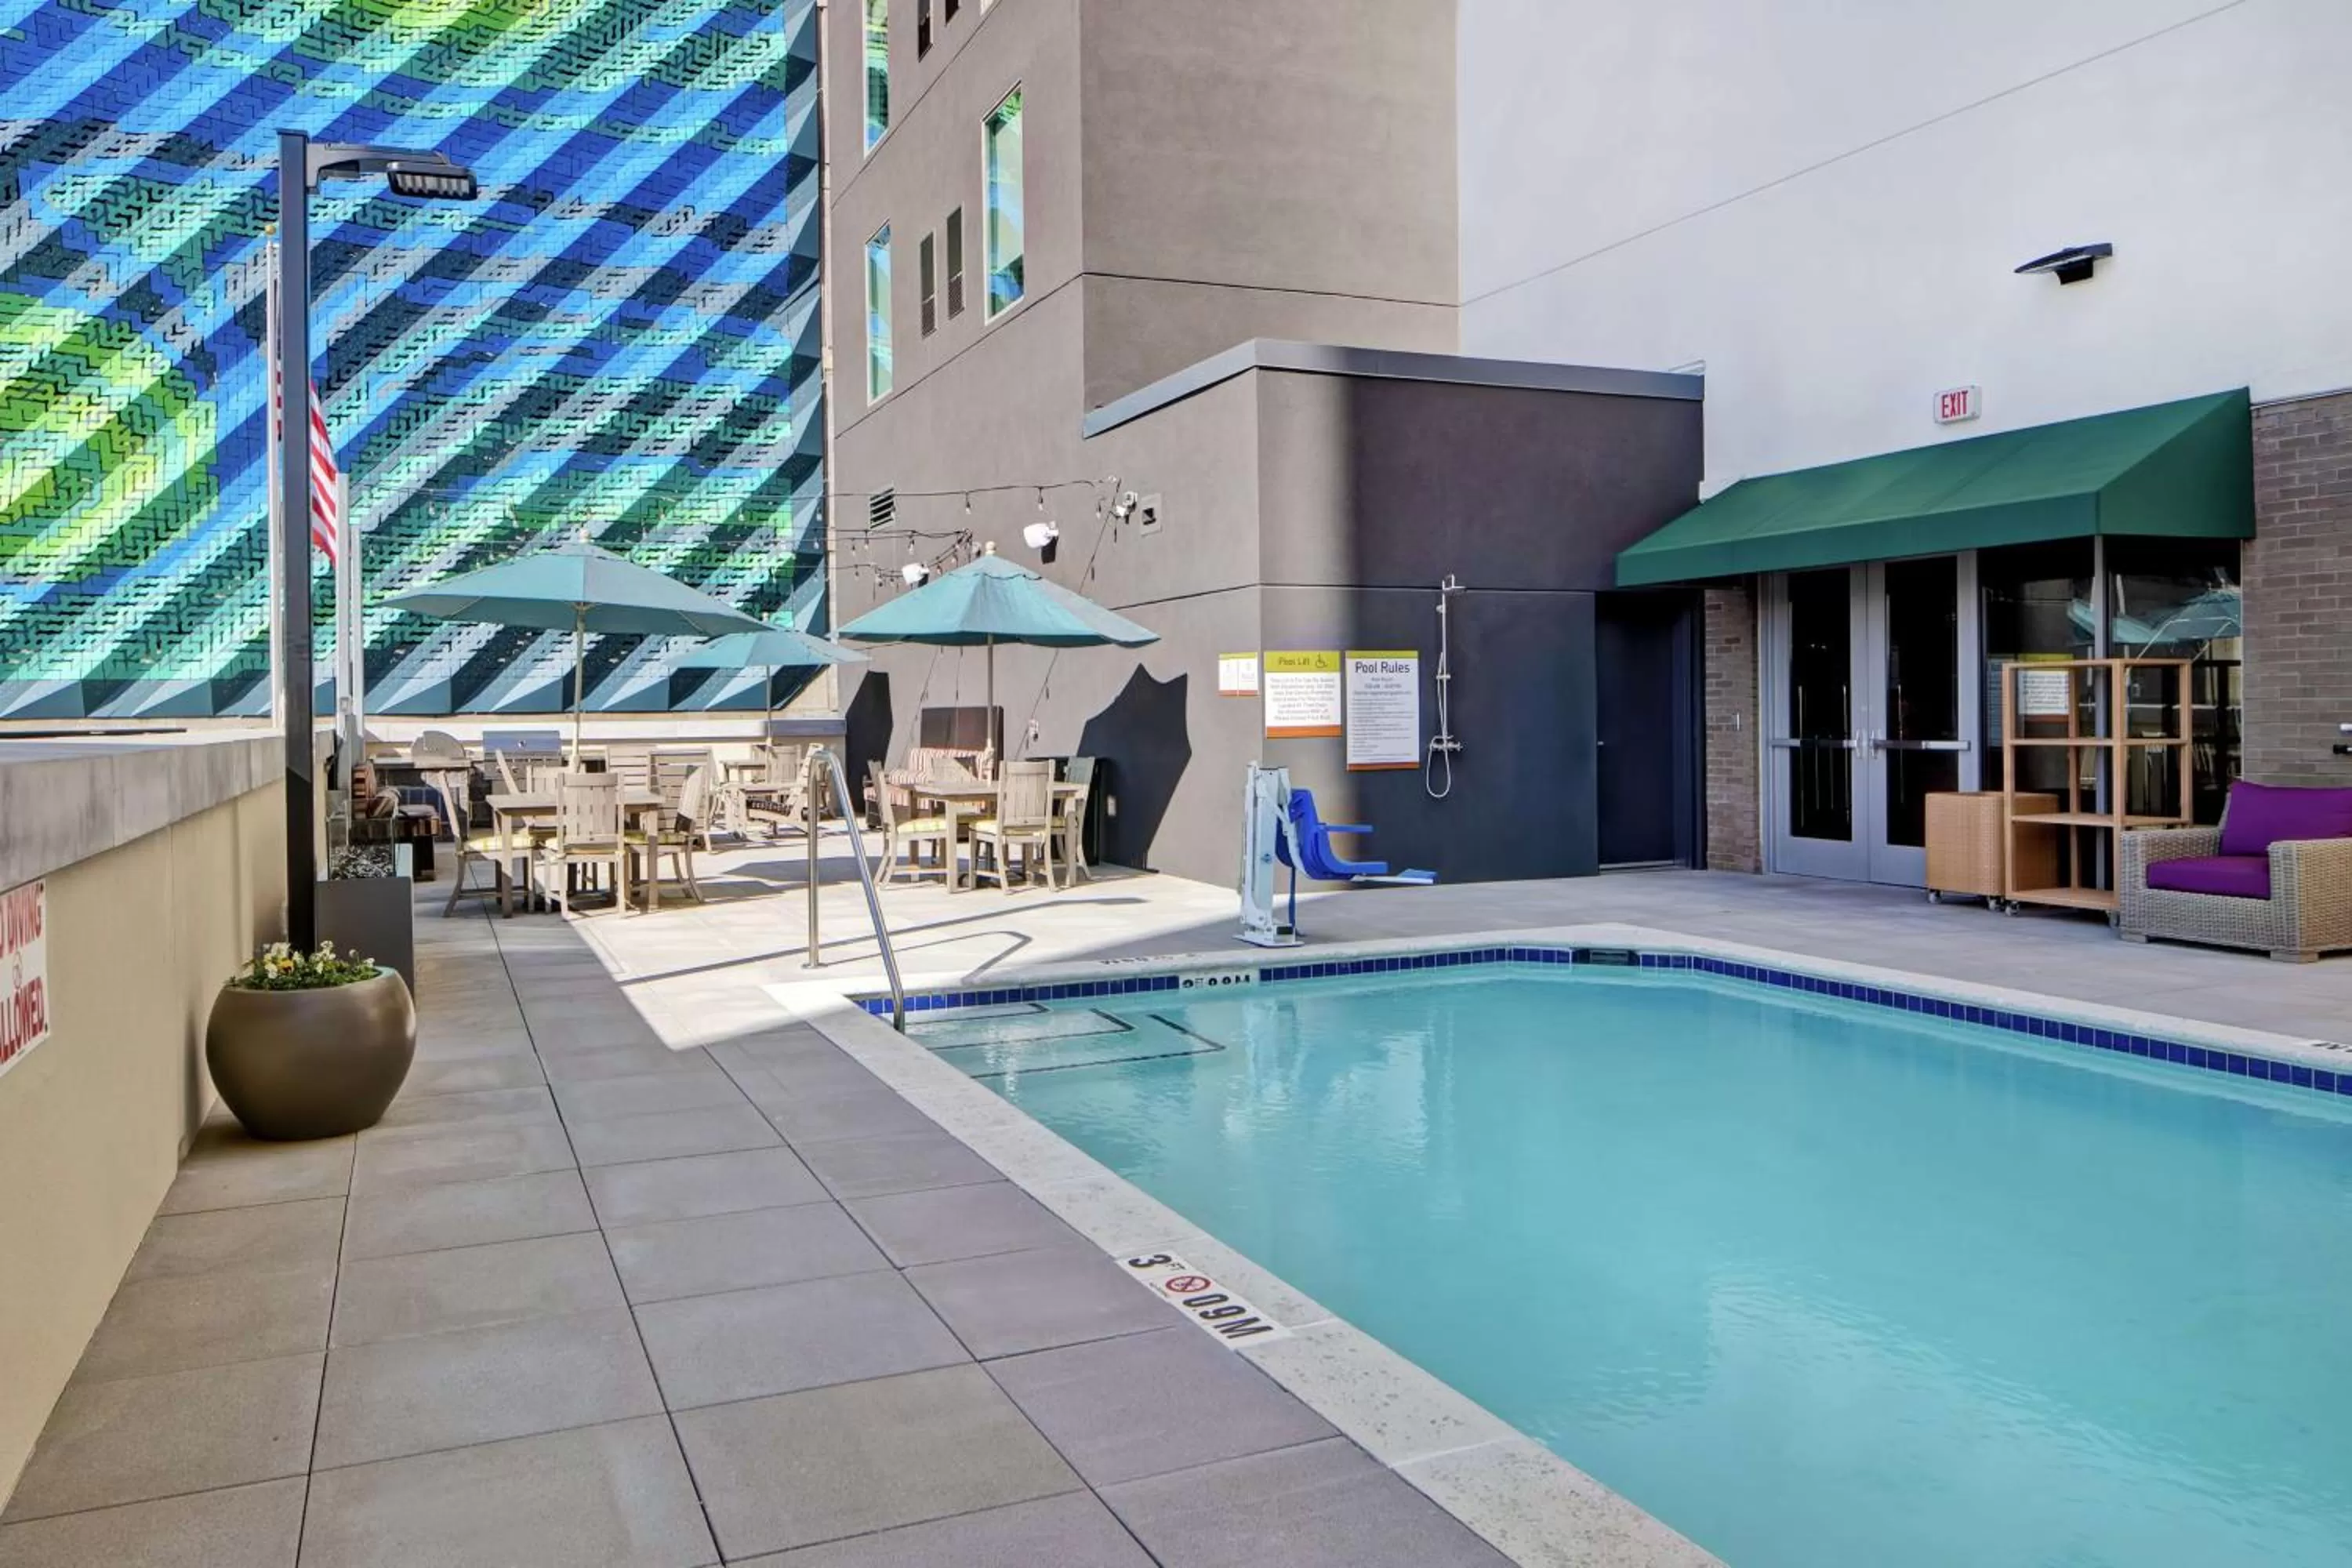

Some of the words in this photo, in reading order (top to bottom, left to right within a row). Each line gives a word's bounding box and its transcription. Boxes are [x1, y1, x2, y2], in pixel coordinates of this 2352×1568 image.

[1942, 390, 1968, 418] EXIT
[1279, 656, 1295, 666] Pool
[1355, 660, 1377, 673] Pool
[1381, 660, 1410, 673] Rules
[8, 883, 42, 954] DIVING
[0, 976, 44, 1064] LLOWED
[1128, 1254, 1172, 1268] 3
[1182, 1293, 1274, 1339] 0.9M
